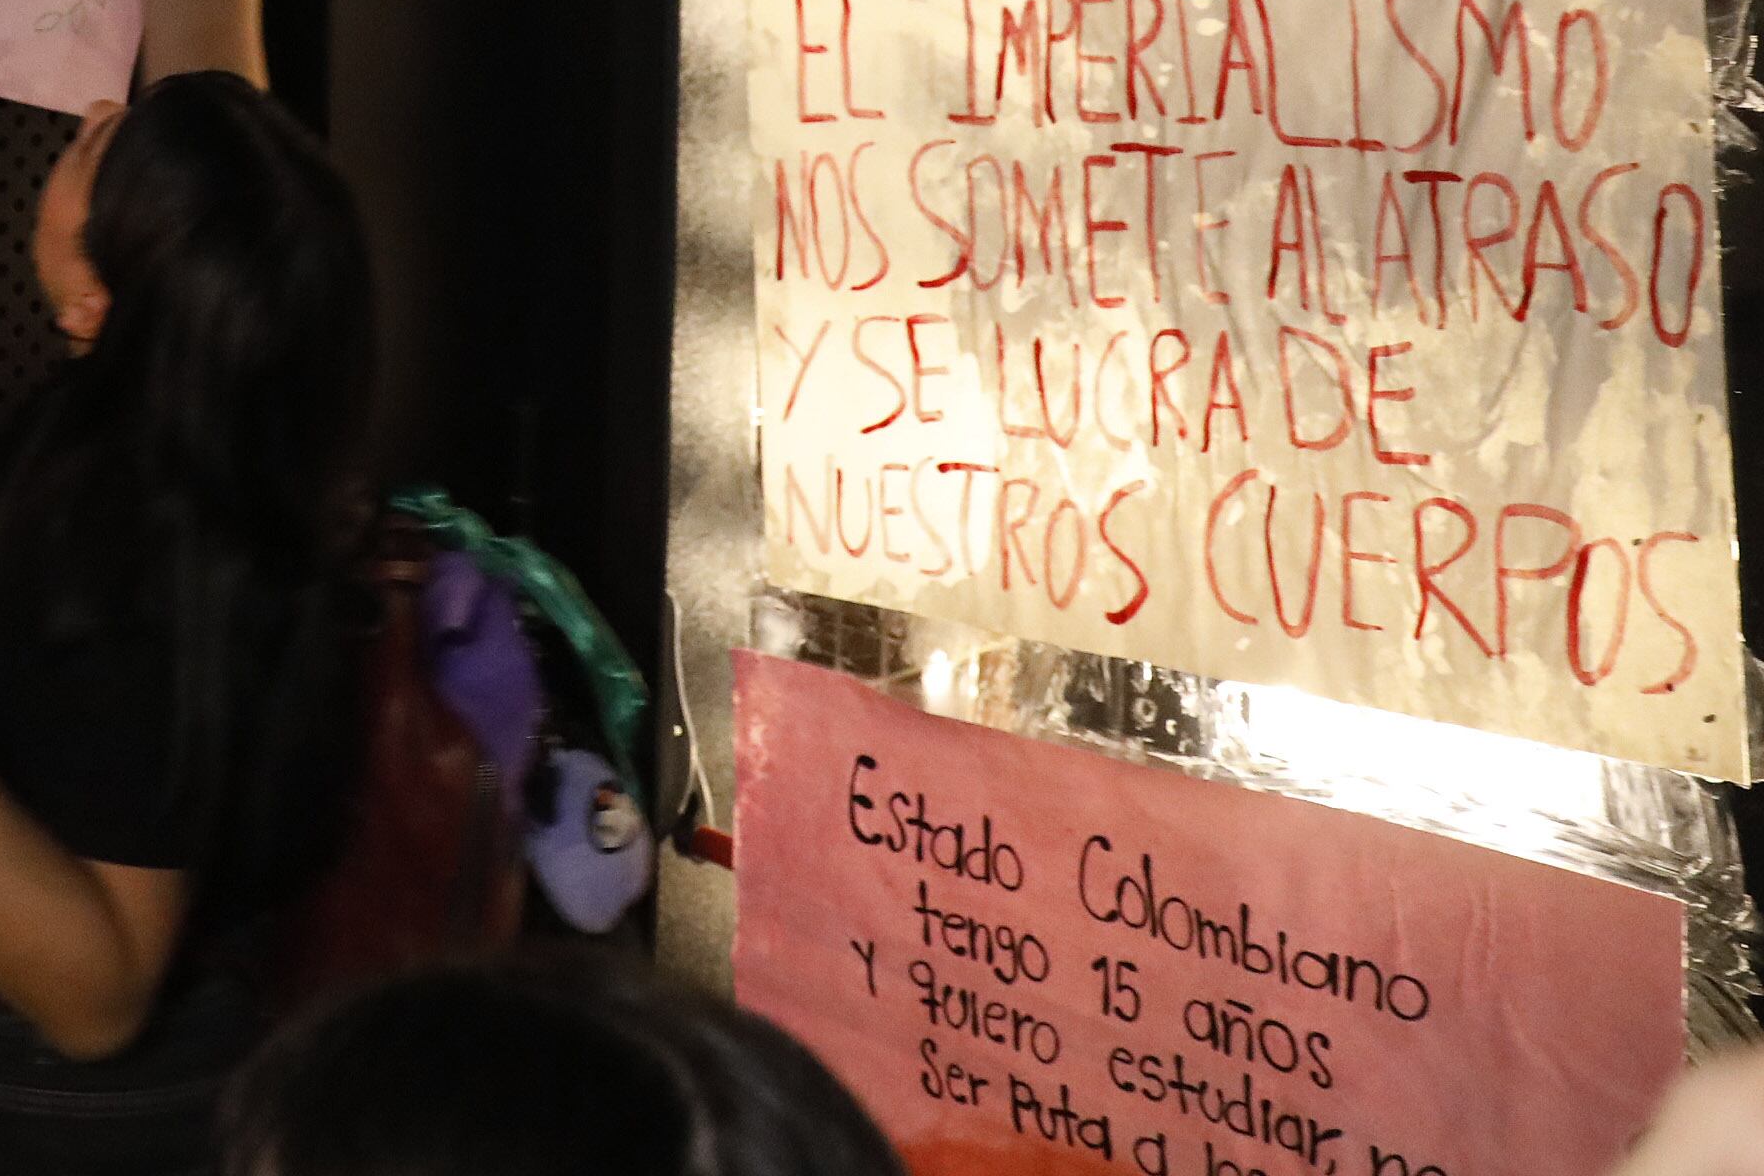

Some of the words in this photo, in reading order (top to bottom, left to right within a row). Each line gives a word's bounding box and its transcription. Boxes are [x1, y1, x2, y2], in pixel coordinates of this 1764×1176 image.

[773, 140, 891, 291] NOS
[908, 137, 1239, 308] SOMETE
[774, 320, 833, 422] Y
[852, 314, 950, 434] SE
[996, 327, 1252, 454] LUCRA
[1278, 325, 1432, 465] DE
[785, 454, 1150, 625] NUESTROS
[1203, 467, 1700, 697] CUERPOS
[848, 754, 1025, 893] Estado
[1078, 834, 1431, 1022] Colombiano
[913, 880, 1050, 985] tengo
[1090, 955, 1142, 1024] 15
[1183, 997, 1334, 1089] años
[907, 959, 1061, 1066] quiero
[1368, 1145, 1448, 1176] n
